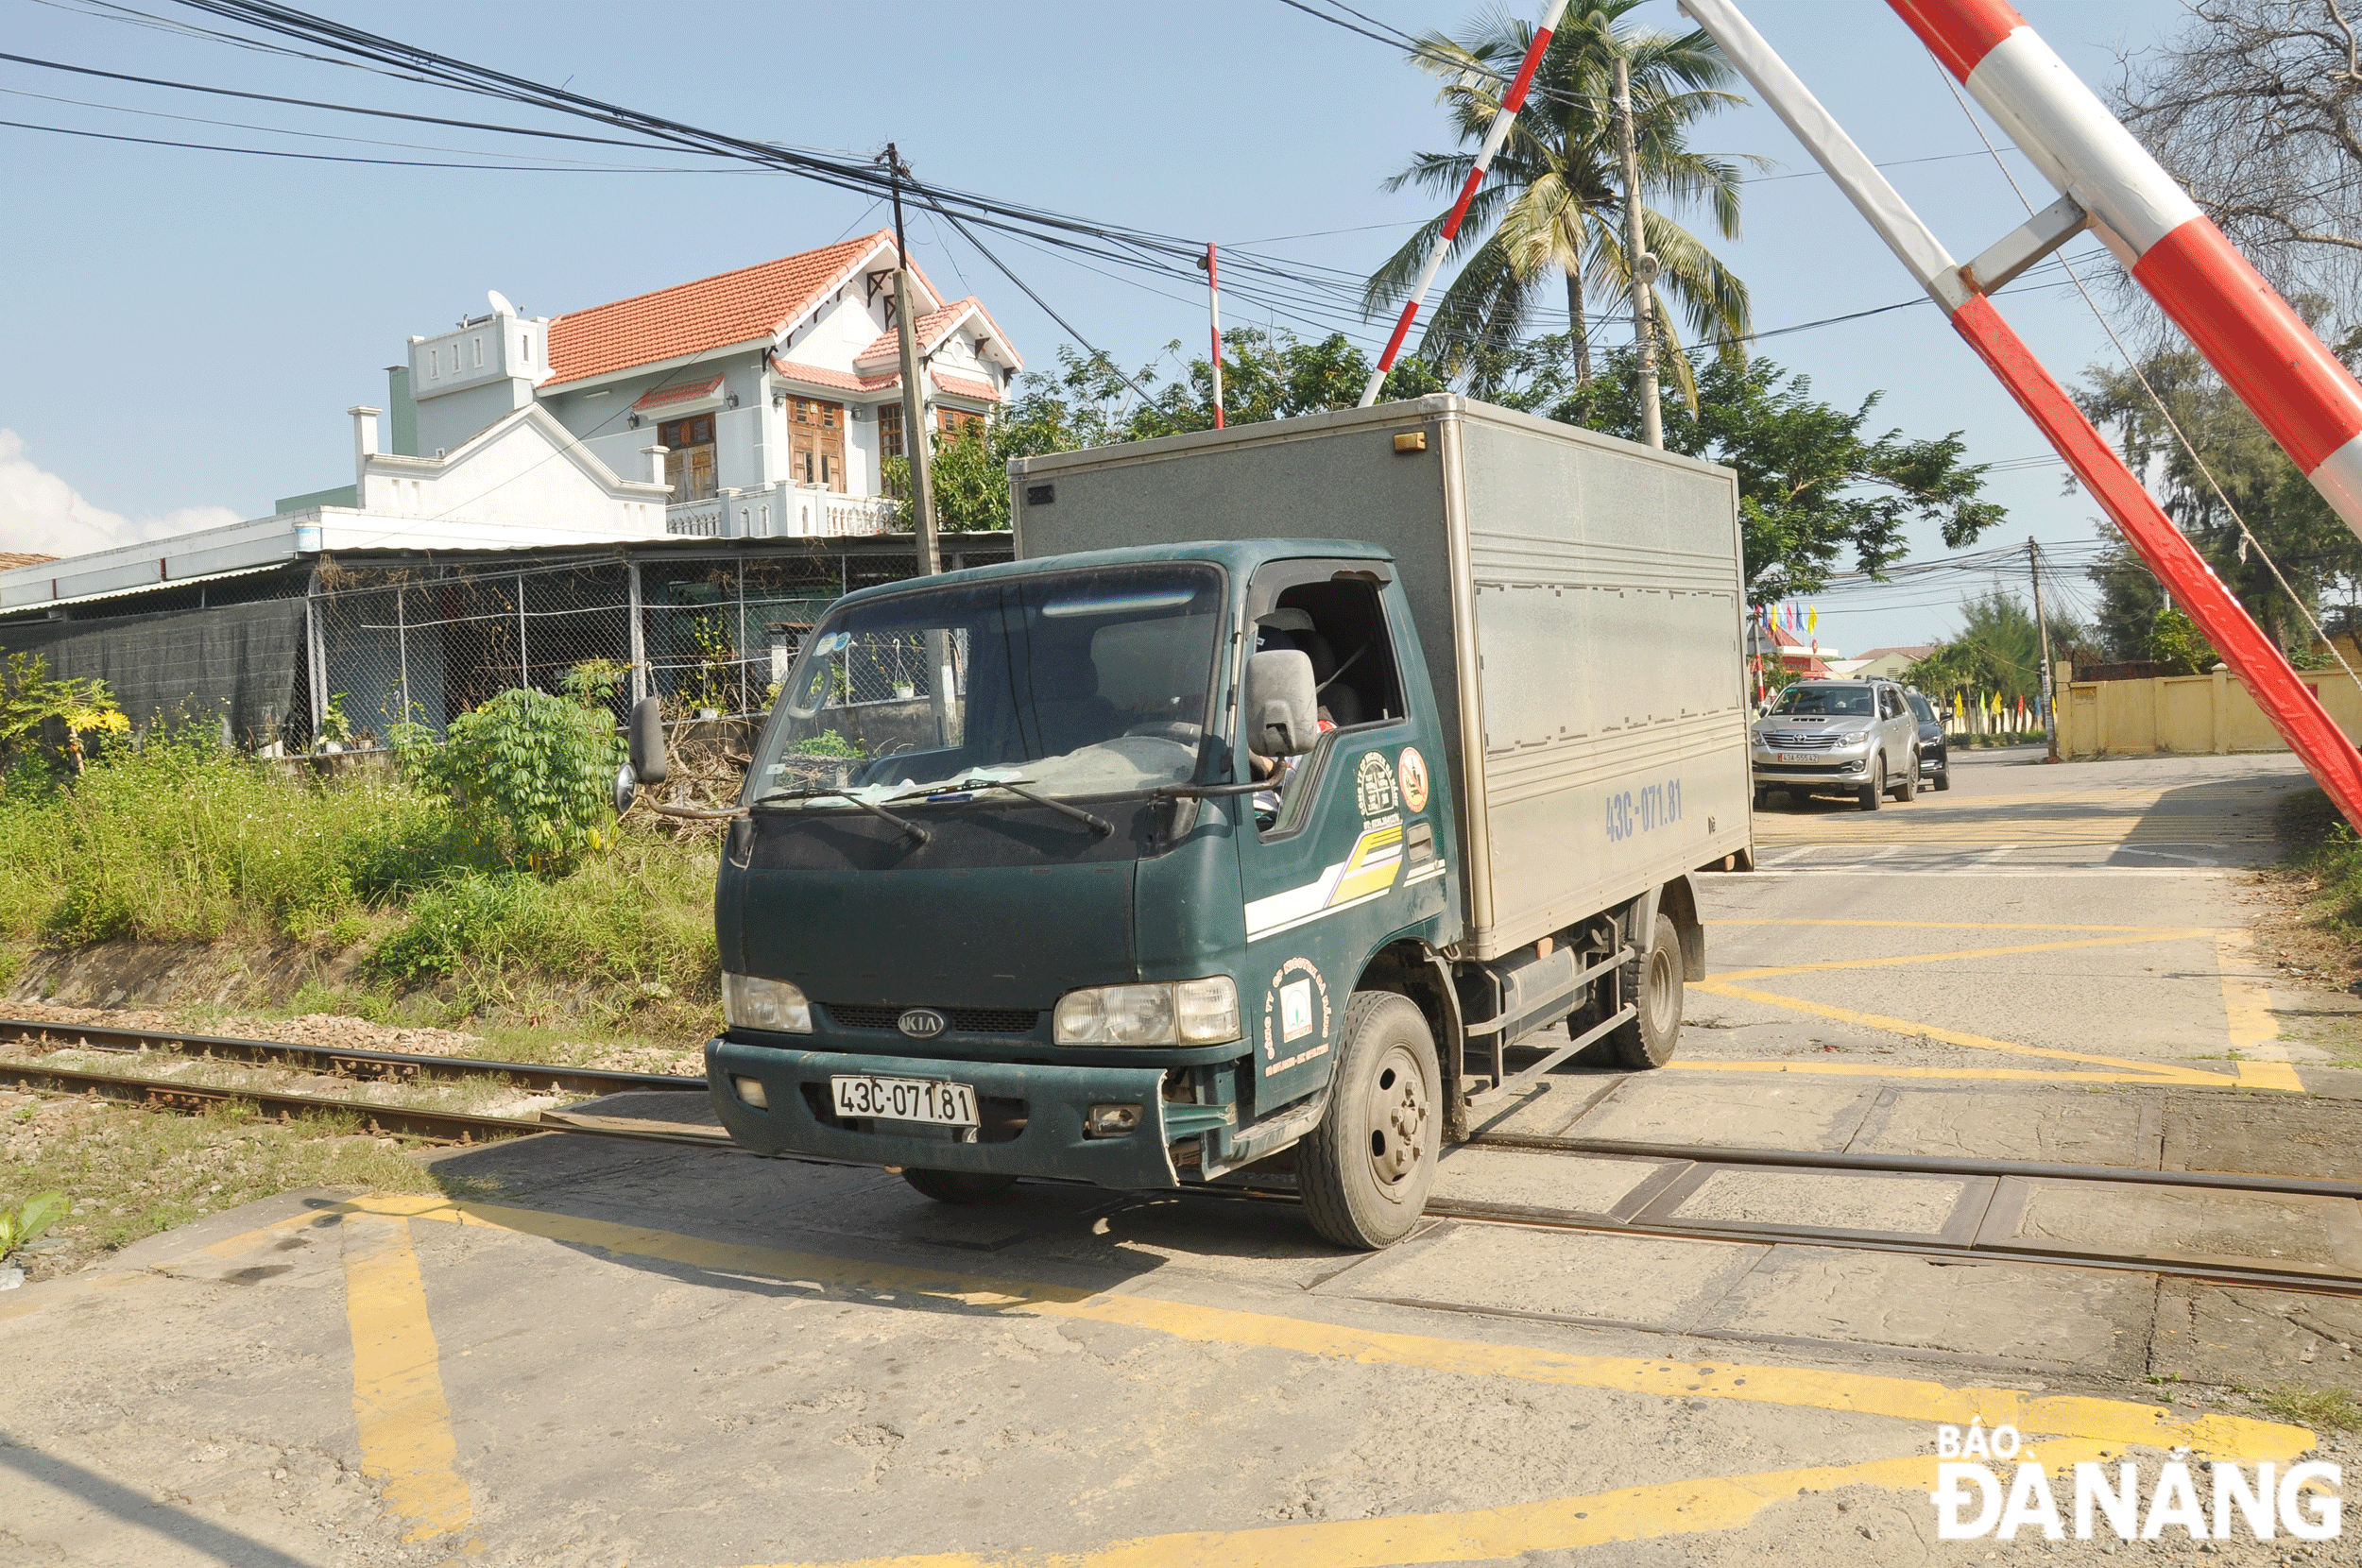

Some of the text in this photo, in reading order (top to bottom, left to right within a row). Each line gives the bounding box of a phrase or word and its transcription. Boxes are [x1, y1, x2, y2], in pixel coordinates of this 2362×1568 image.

[1606, 777, 1682, 843] 43C-071.81
[1283, 957, 1319, 980] NICOTEX
[904, 1016, 936, 1031] KIA
[840, 1081, 970, 1122] 43C-071.81
